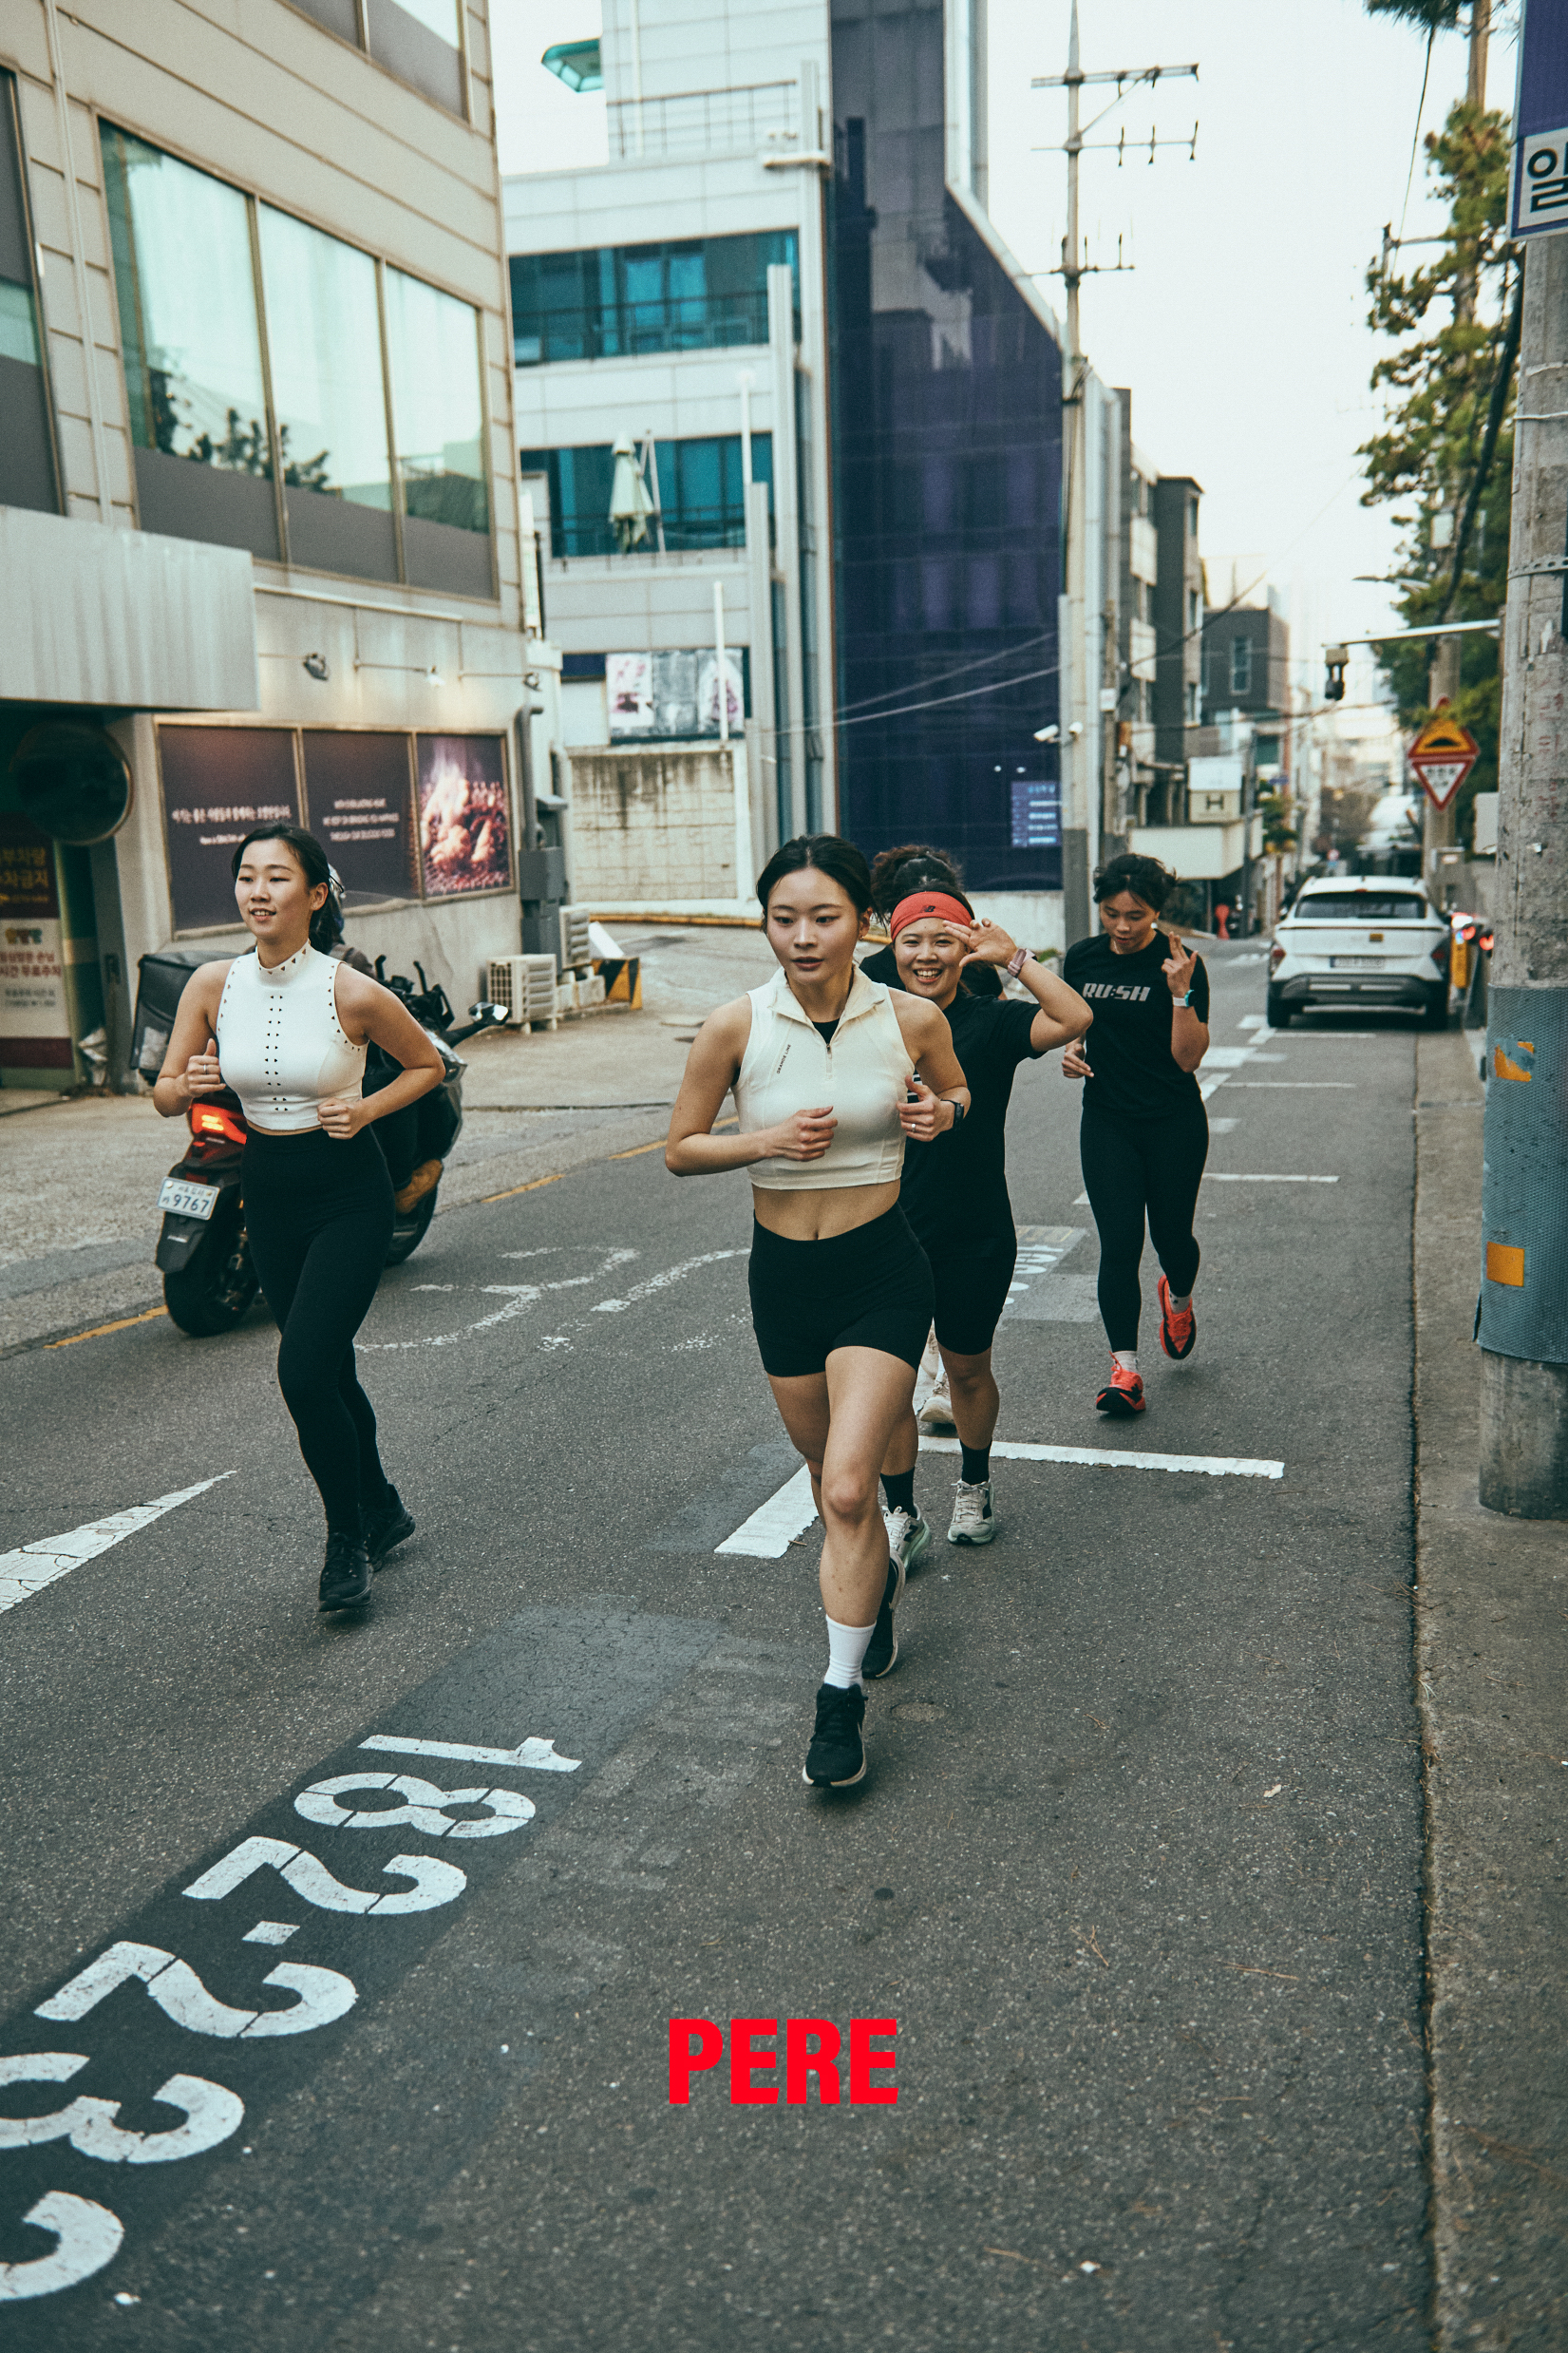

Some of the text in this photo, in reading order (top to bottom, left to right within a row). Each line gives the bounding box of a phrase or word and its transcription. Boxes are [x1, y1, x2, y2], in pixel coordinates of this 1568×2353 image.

[1205, 794, 1224, 810] H
[1083, 982, 1151, 1002] RU:SH
[174, 1194, 209, 1213] 9767
